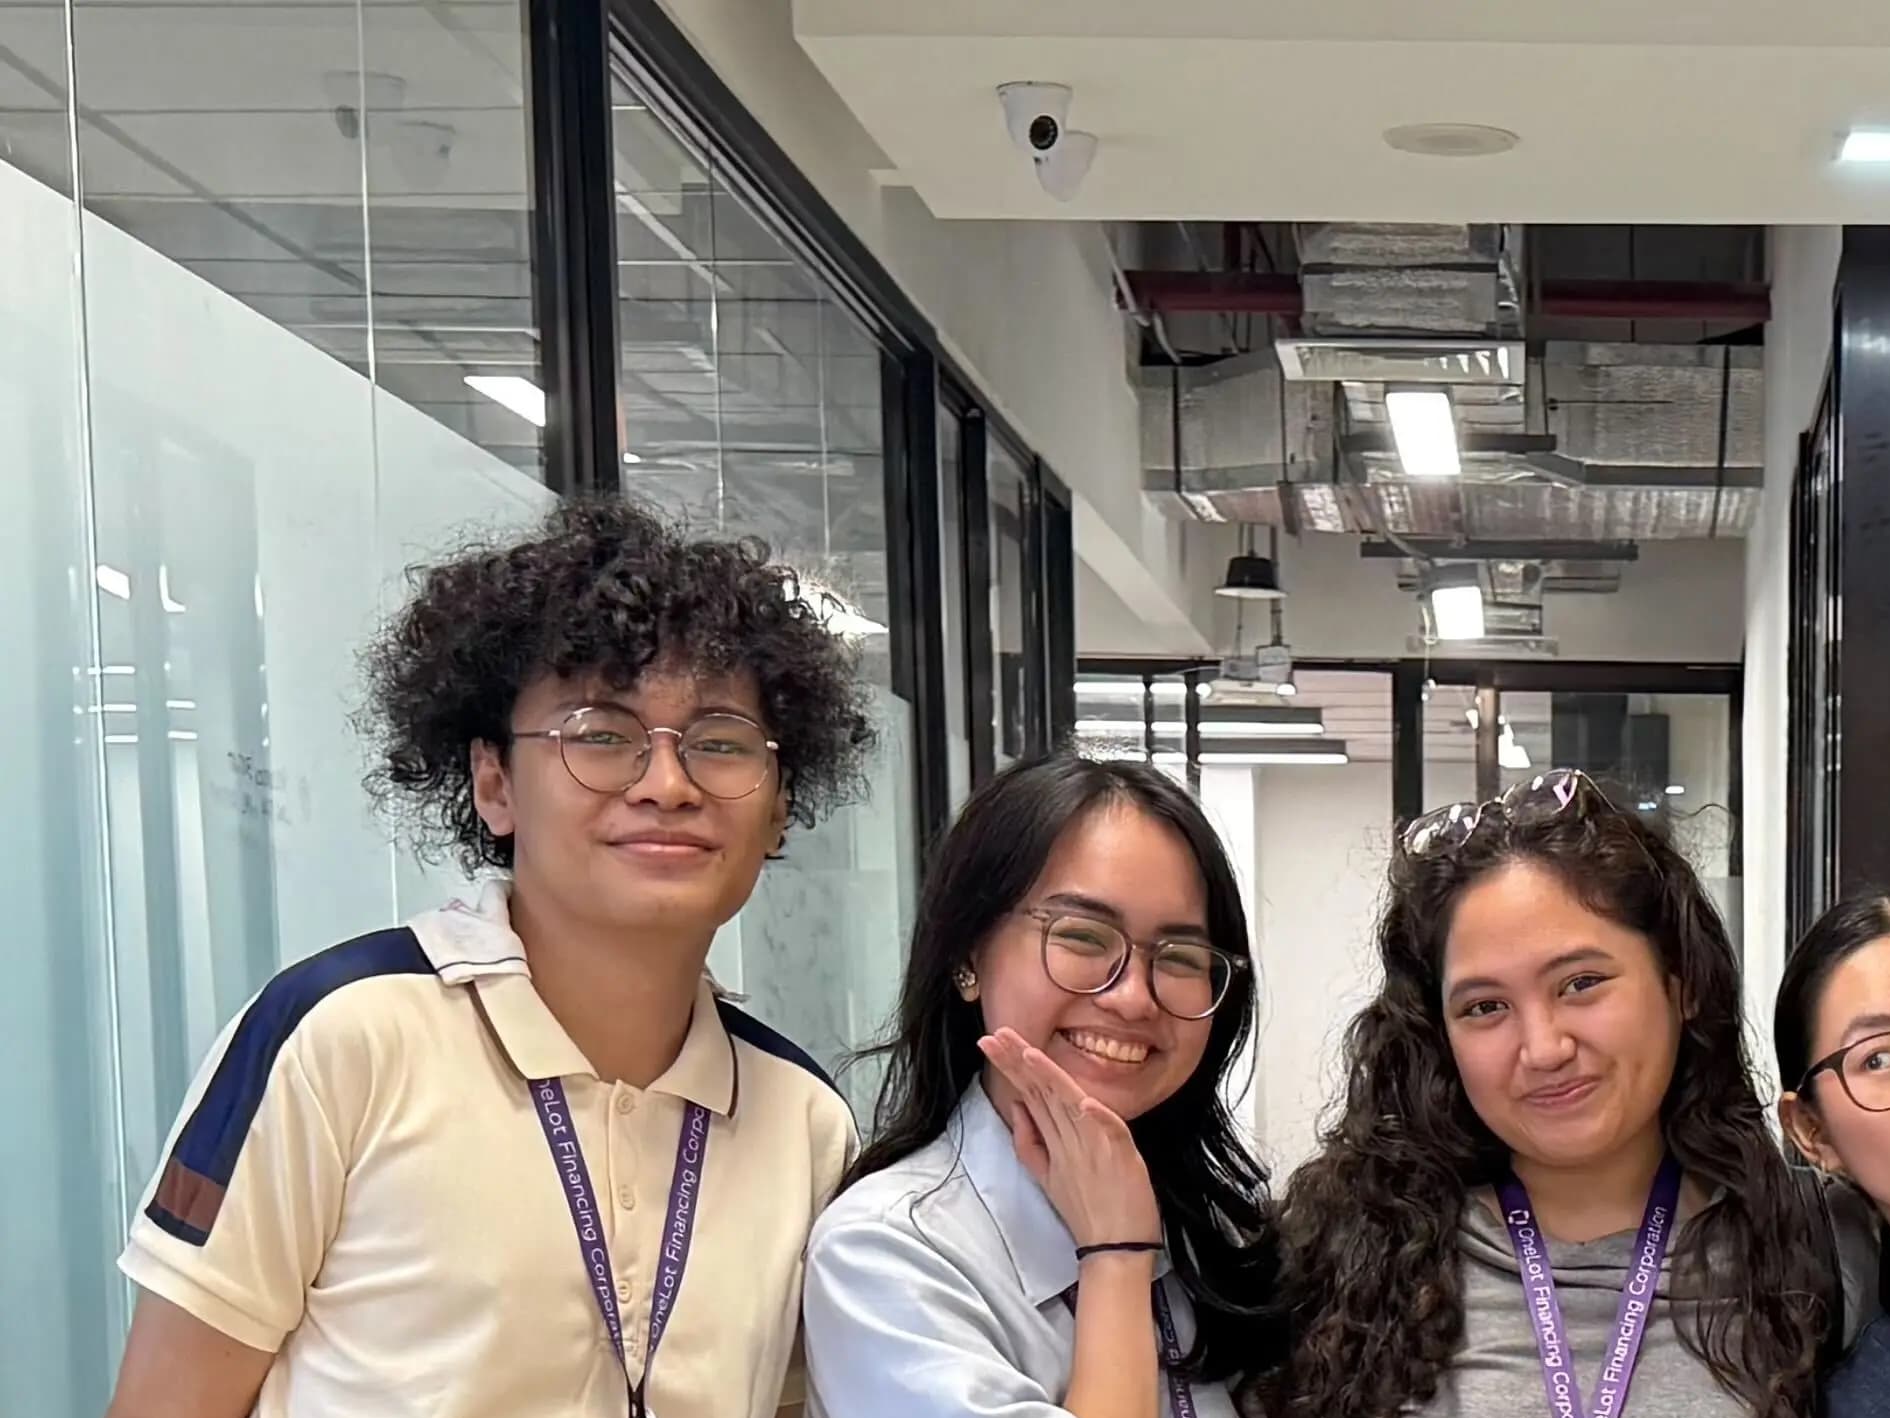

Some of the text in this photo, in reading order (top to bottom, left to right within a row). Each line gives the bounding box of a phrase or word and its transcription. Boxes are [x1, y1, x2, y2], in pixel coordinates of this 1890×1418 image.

[538, 1079, 568, 1137] neLot
[558, 1139, 598, 1242] Financing
[651, 1265, 678, 1339] OneLot
[665, 1168, 698, 1263] Financing
[1518, 1227, 1545, 1281] OneLot
[1532, 1285, 1563, 1367] Financing
[1602, 1300, 1645, 1384] Financing
[1628, 1205, 1669, 1296] Corporation
